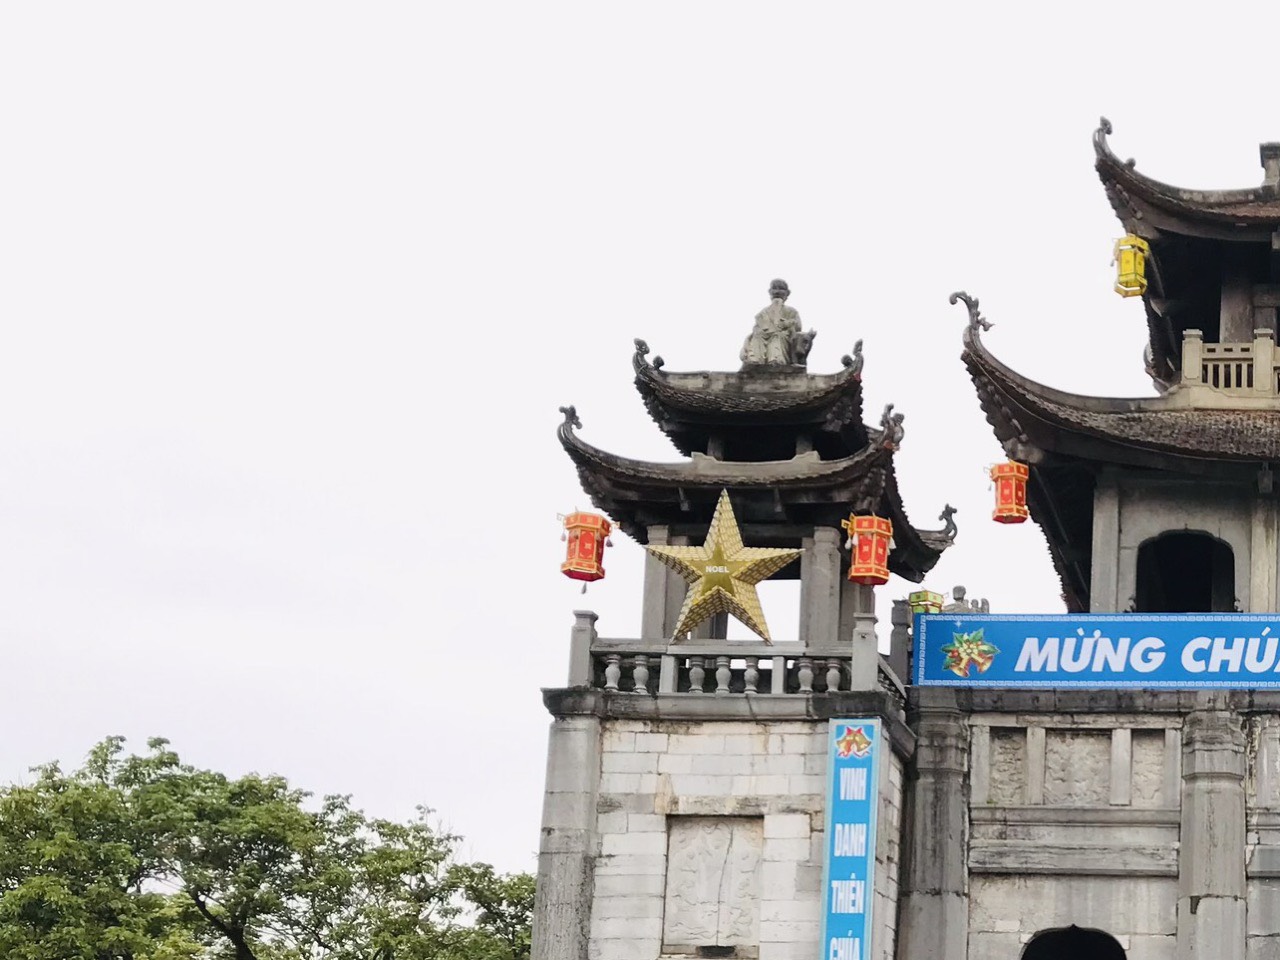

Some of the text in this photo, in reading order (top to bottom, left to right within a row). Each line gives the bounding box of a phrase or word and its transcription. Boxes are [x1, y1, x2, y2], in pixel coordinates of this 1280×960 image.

[705, 565, 730, 573] NOEL
[1015, 627, 1167, 674] MỪNG
[840, 768, 867, 801] VINH
[834, 824, 866, 857] DANH
[831, 873, 864, 914] THIÊN
